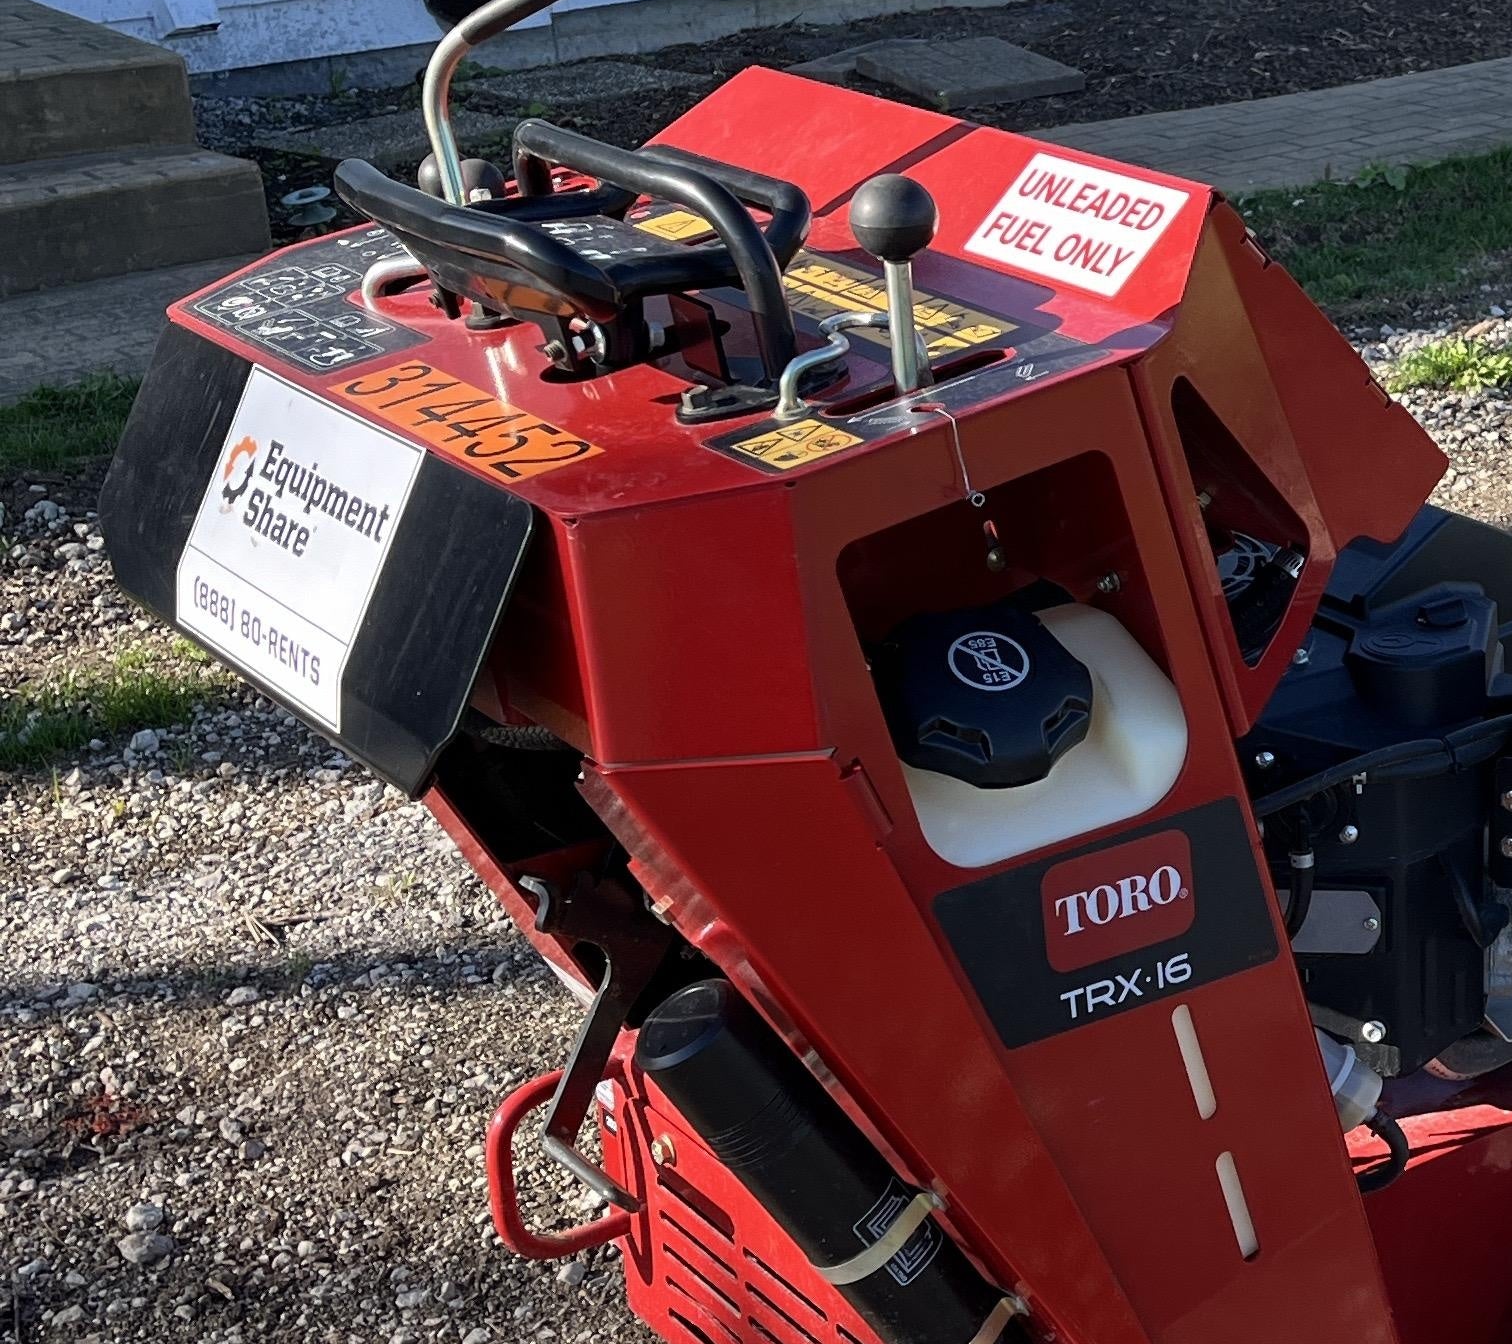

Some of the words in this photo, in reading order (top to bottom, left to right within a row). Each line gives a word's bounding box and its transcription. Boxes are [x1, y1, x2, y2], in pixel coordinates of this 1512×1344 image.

[1018, 168, 1165, 231] UNLEADED
[981, 211, 1052, 256] FUEL
[1053, 232, 1135, 277] ONLY
[344, 364, 592, 479] 314452
[242, 487, 311, 557] Share
[259, 439, 390, 543] Equipment
[193, 575, 236, 631] (888)
[240, 609, 321, 686] 80-RENTS
[982, 671, 1012, 684] E15
[1054, 865, 1182, 936] TORO
